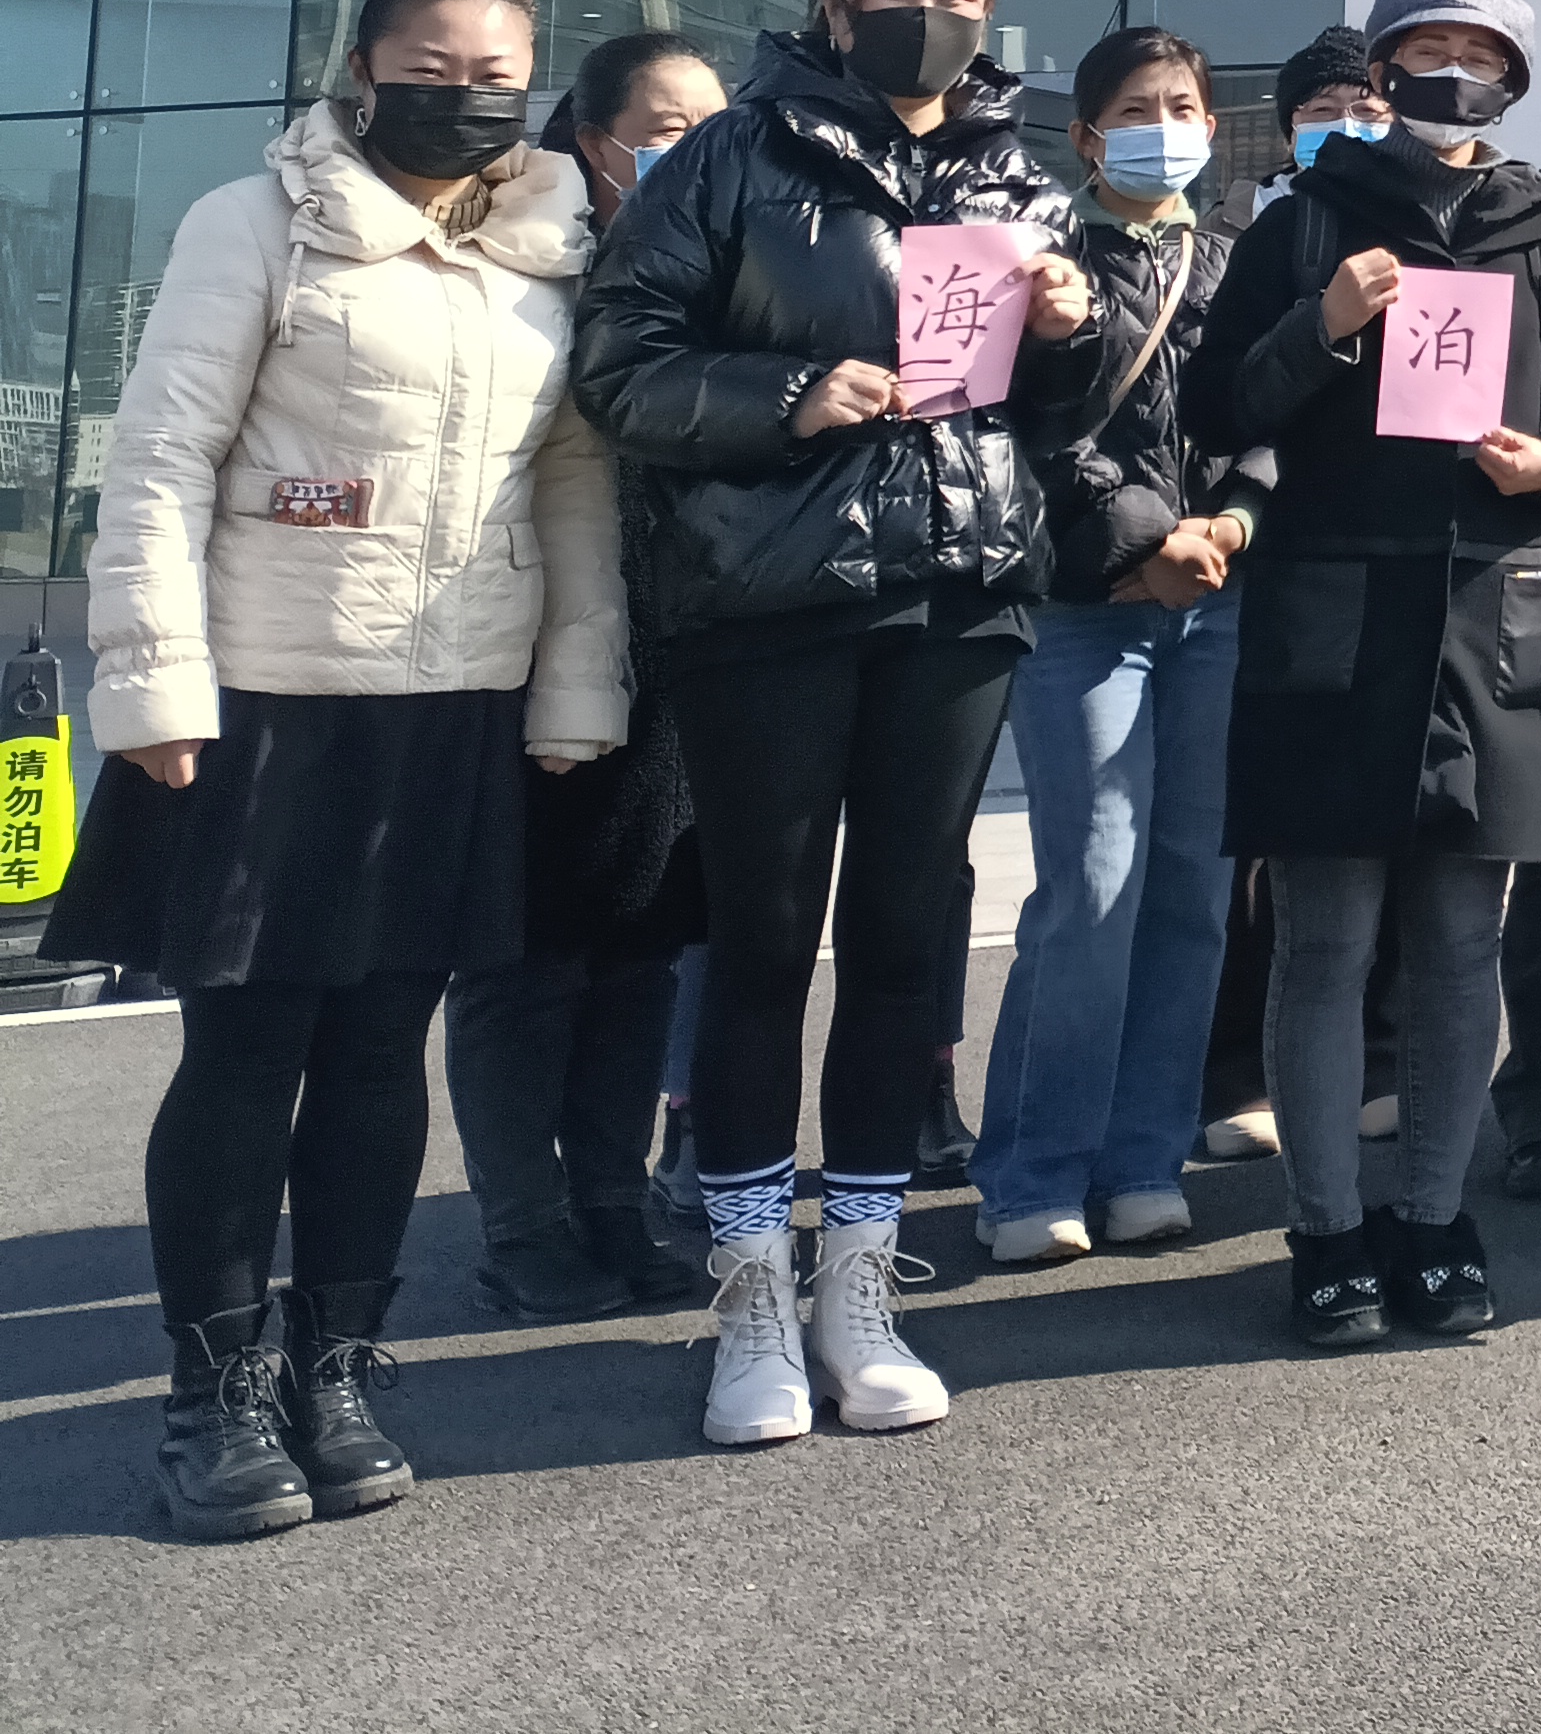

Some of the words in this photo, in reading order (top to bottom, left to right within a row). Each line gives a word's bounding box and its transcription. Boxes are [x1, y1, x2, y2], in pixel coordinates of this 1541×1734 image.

[911, 263, 996, 350] 海
[1408, 307, 1475, 377] 泊
[0, 749, 48, 889] 请勿泊车
[829, 1192, 903, 1221] UGG
